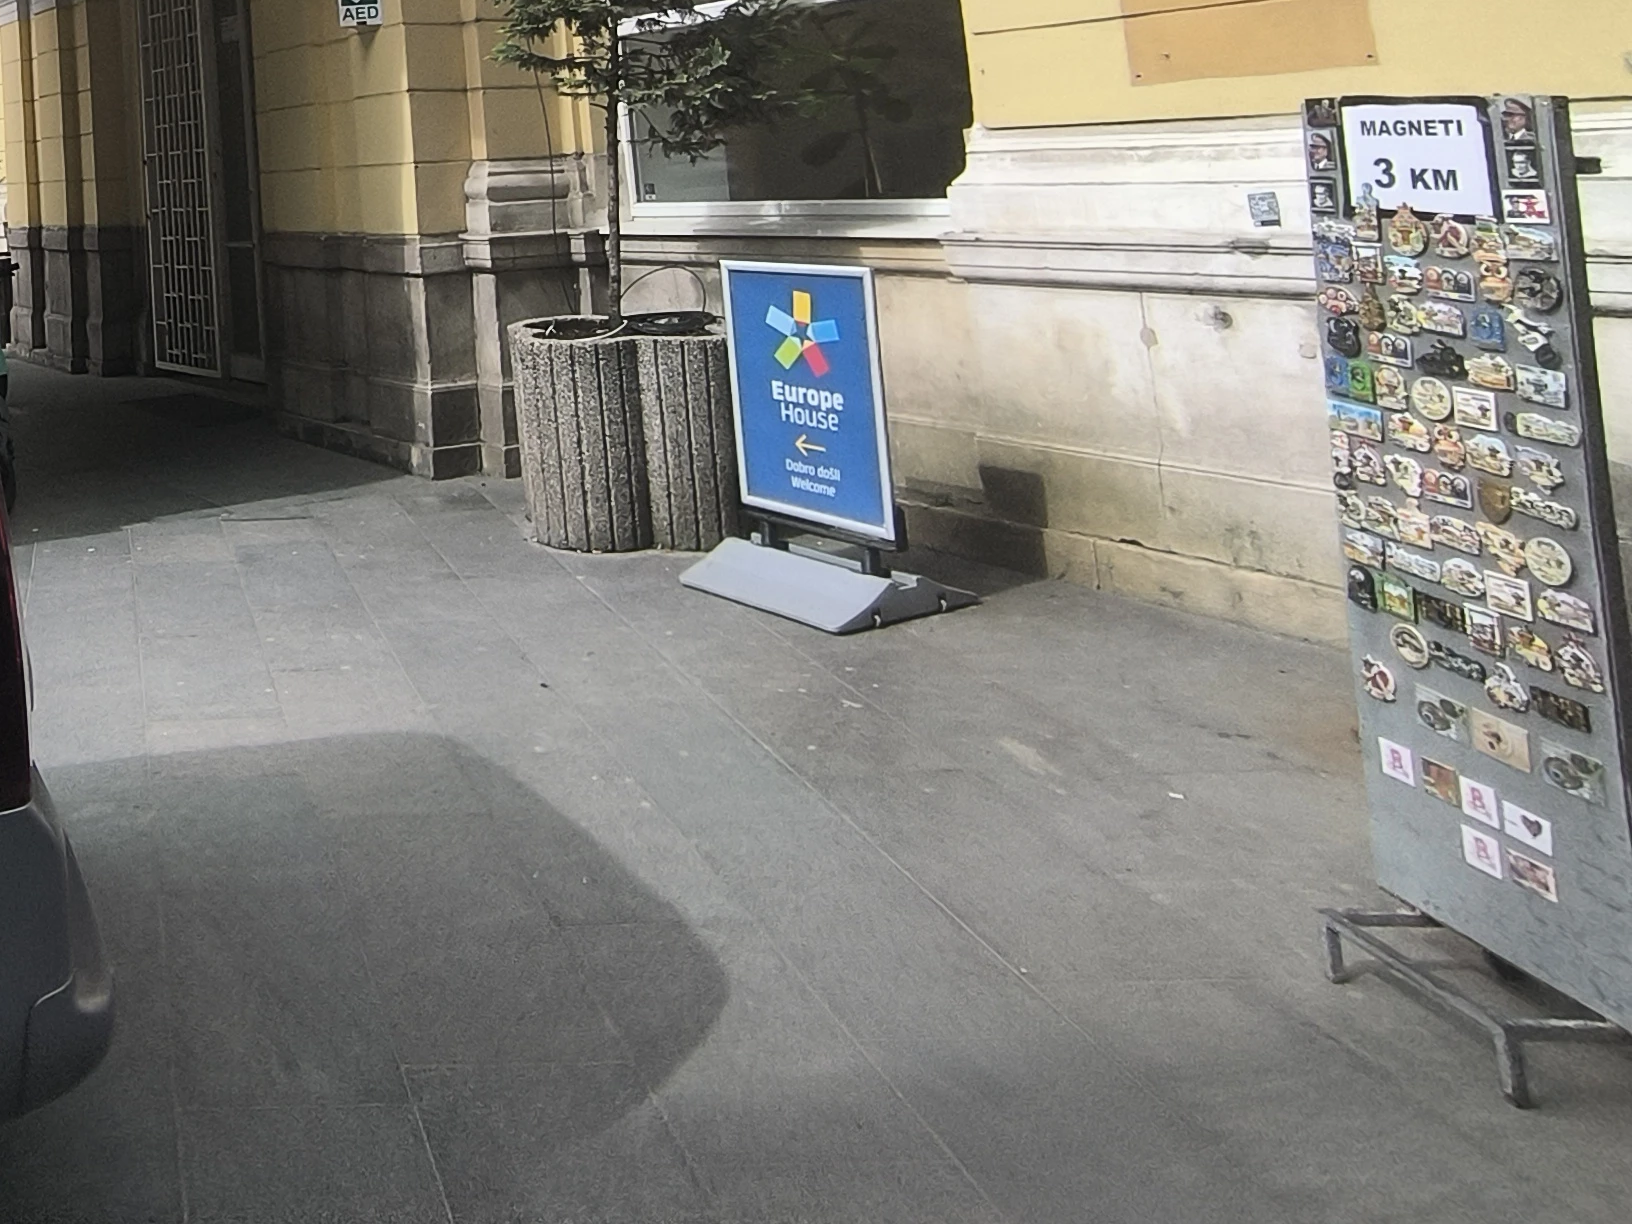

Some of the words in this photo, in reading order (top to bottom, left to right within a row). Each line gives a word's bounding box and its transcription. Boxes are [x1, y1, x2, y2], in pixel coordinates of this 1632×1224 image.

[342, 5, 379, 22] AED
[1360, 119, 1463, 137] MAGNETI
[1374, 158, 1396, 189] 3
[1411, 167, 1459, 191] KM
[771, 380, 844, 410] Europe
[780, 403, 839, 431] House
[785, 457, 816, 476] Dobro
[817, 465, 841, 482] došli
[791, 475, 836, 497] Welcome
